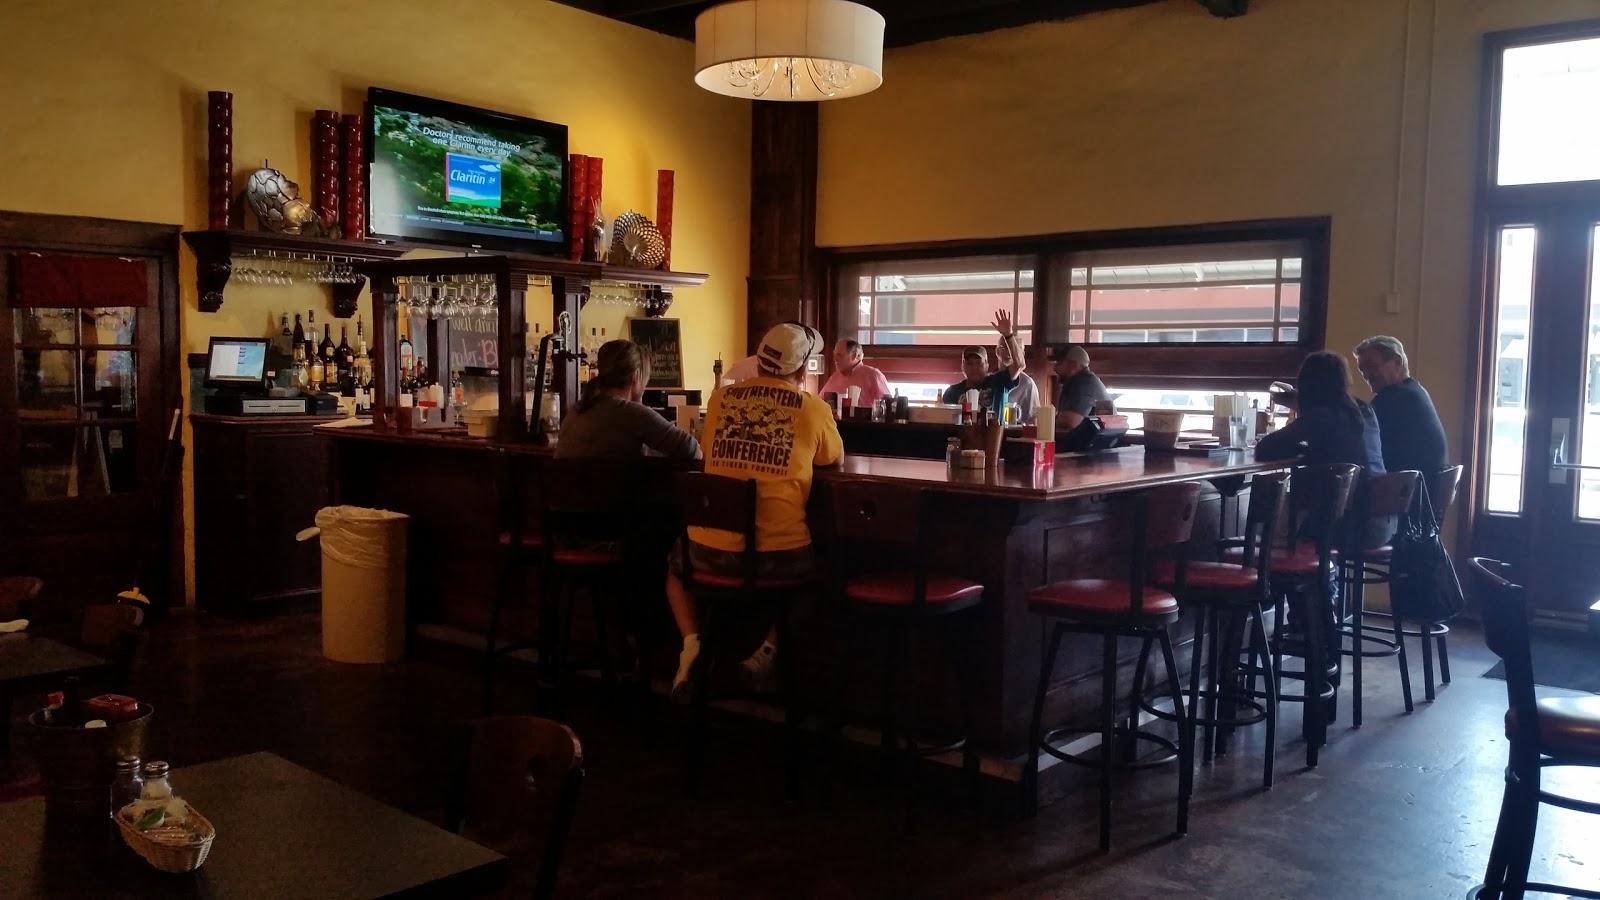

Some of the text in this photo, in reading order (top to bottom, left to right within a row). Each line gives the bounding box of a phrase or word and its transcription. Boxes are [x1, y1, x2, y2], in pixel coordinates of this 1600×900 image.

[450, 140, 476, 150] Claritin
[477, 145, 497, 154] every
[455, 134, 497, 147] recommend
[498, 141, 521, 153] taking
[450, 169, 485, 185] Claritin
[723, 386, 803, 409] SOUTHEASTERN
[711, 439, 792, 467] CONFERENCE
